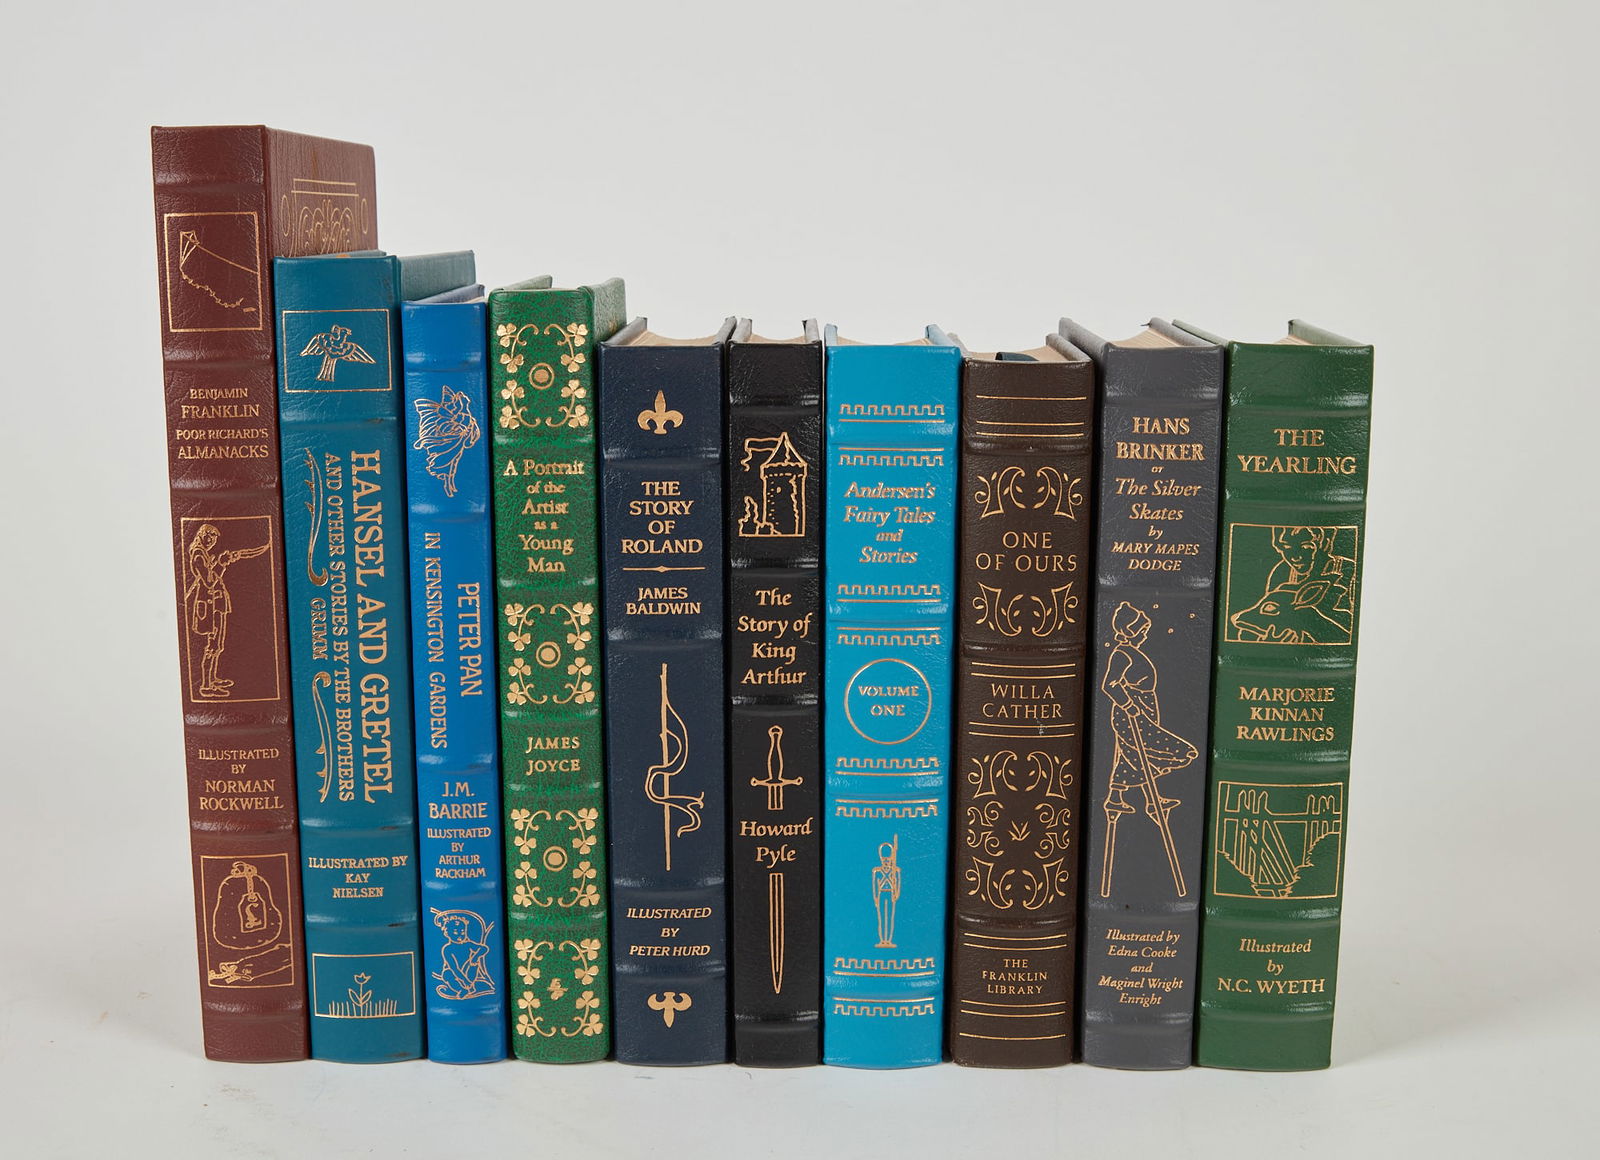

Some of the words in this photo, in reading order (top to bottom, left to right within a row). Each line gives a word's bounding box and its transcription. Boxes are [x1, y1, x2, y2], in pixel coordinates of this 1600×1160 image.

[190, 388, 248, 399] BENJAMIN
[181, 404, 260, 418] FRANKLIN
[176, 430, 206, 440] POOR
[208, 428, 268, 440] RICHARD'S
[1132, 417, 1190, 435] HANS
[1273, 428, 1325, 447] THE
[178, 446, 268, 459] ALMANACKS
[1115, 442, 1205, 462] BRINKER
[325, 453, 342, 490] AND
[503, 460, 518, 476] A
[523, 459, 584, 476] Portrait
[1237, 454, 1358, 474] YEARLING
[527, 481, 541, 494] of
[544, 481, 566, 493] the
[641, 481, 681, 496] THE
[844, 481, 936, 499] Andersen's
[1115, 478, 1148, 496] The
[1151, 480, 1202, 497] Silver
[522, 499, 569, 515] Artist
[629, 500, 694, 516] STORY
[1128, 502, 1184, 521] Skates
[351, 450, 384, 587] HANSEL
[843, 505, 890, 528] Fairy
[894, 506, 936, 524] Tales
[327, 495, 345, 556] OTHER
[534, 520, 547, 530] as
[550, 520, 558, 530] a
[648, 520, 676, 535] OF
[1148, 525, 1163, 540] by
[425, 532, 440, 549] IN
[876, 529, 904, 542] and
[1002, 531, 1052, 549] ONE
[518, 534, 574, 555] Young
[621, 539, 704, 554] ROLAND
[1110, 541, 1152, 554] MARY
[1155, 542, 1200, 556] MAPES
[859, 546, 918, 564] Stories
[975, 552, 1005, 570] OF
[1014, 554, 1078, 572] OURS
[527, 557, 566, 573] Man
[1128, 558, 1182, 572] DODGE
[331, 561, 349, 636] STORIES
[638, 587, 688, 602] JAMES
[755, 588, 792, 606] The
[425, 558, 444, 662] KENSINGTON
[458, 582, 481, 650] PETER
[626, 602, 702, 616] BALDWIN
[311, 597, 328, 660] GRIMM
[357, 593, 388, 664] AND
[737, 616, 788, 638] Story
[791, 613, 813, 637] of
[333, 641, 350, 666] BY
[751, 643, 797, 665] King
[460, 654, 482, 697] PAN
[741, 667, 806, 686] Arthur
[334, 667, 350, 703] THE
[858, 686, 920, 698] VOLUME
[990, 683, 1056, 700] WILLA
[1238, 686, 1336, 706] MARJORIE
[429, 671, 446, 748] GARDENS
[870, 704, 906, 716] ONE
[982, 703, 1062, 720] CATHER
[1250, 707, 1324, 722] KINNAN
[360, 673, 392, 804] GRETEL
[1236, 726, 1335, 742] RAWLINGS
[526, 736, 581, 753] JAMES
[198, 748, 279, 760] ILLUSTRATED
[336, 708, 354, 801] BROTHERS
[231, 764, 247, 774] BY
[526, 758, 581, 776] JOYCE
[205, 780, 275, 793] NORMAN
[442, 782, 475, 798] J.M.
[200, 796, 284, 810] ROCKWELL
[429, 802, 488, 820] BARRIE
[427, 827, 492, 838] ILLUSTRATED
[739, 820, 813, 838] Howard
[451, 842, 464, 852] BY
[308, 856, 389, 869] ILLUSTRATED
[392, 856, 408, 866] BY
[438, 855, 480, 865] ARTHUR
[755, 846, 796, 868] Pyle
[344, 873, 370, 884] KAY
[435, 868, 486, 878] RACKHAM
[332, 888, 384, 899] NIELSEN
[626, 908, 712, 919] ILLUSTRATED
[660, 928, 680, 938] BY
[1105, 928, 1164, 943] Illustrated
[1166, 931, 1180, 944] by
[629, 945, 670, 956] PETER
[672, 945, 711, 956] HURD
[1107, 944, 1138, 958] Edna
[1141, 946, 1177, 958] Cooke
[1239, 938, 1312, 954] Illustrated
[1003, 958, 1028, 968] THE
[1130, 962, 1154, 974] and
[1266, 960, 1284, 975] by
[982, 971, 1048, 982] FRANKLIN
[1098, 975, 1144, 992] Maginel
[1148, 977, 1184, 993] Wright
[986, 984, 1044, 995] LIBRARY
[1218, 978, 1253, 994] N.C.
[1256, 978, 1325, 994] WYETH
[1119, 993, 1162, 1008] Enright
